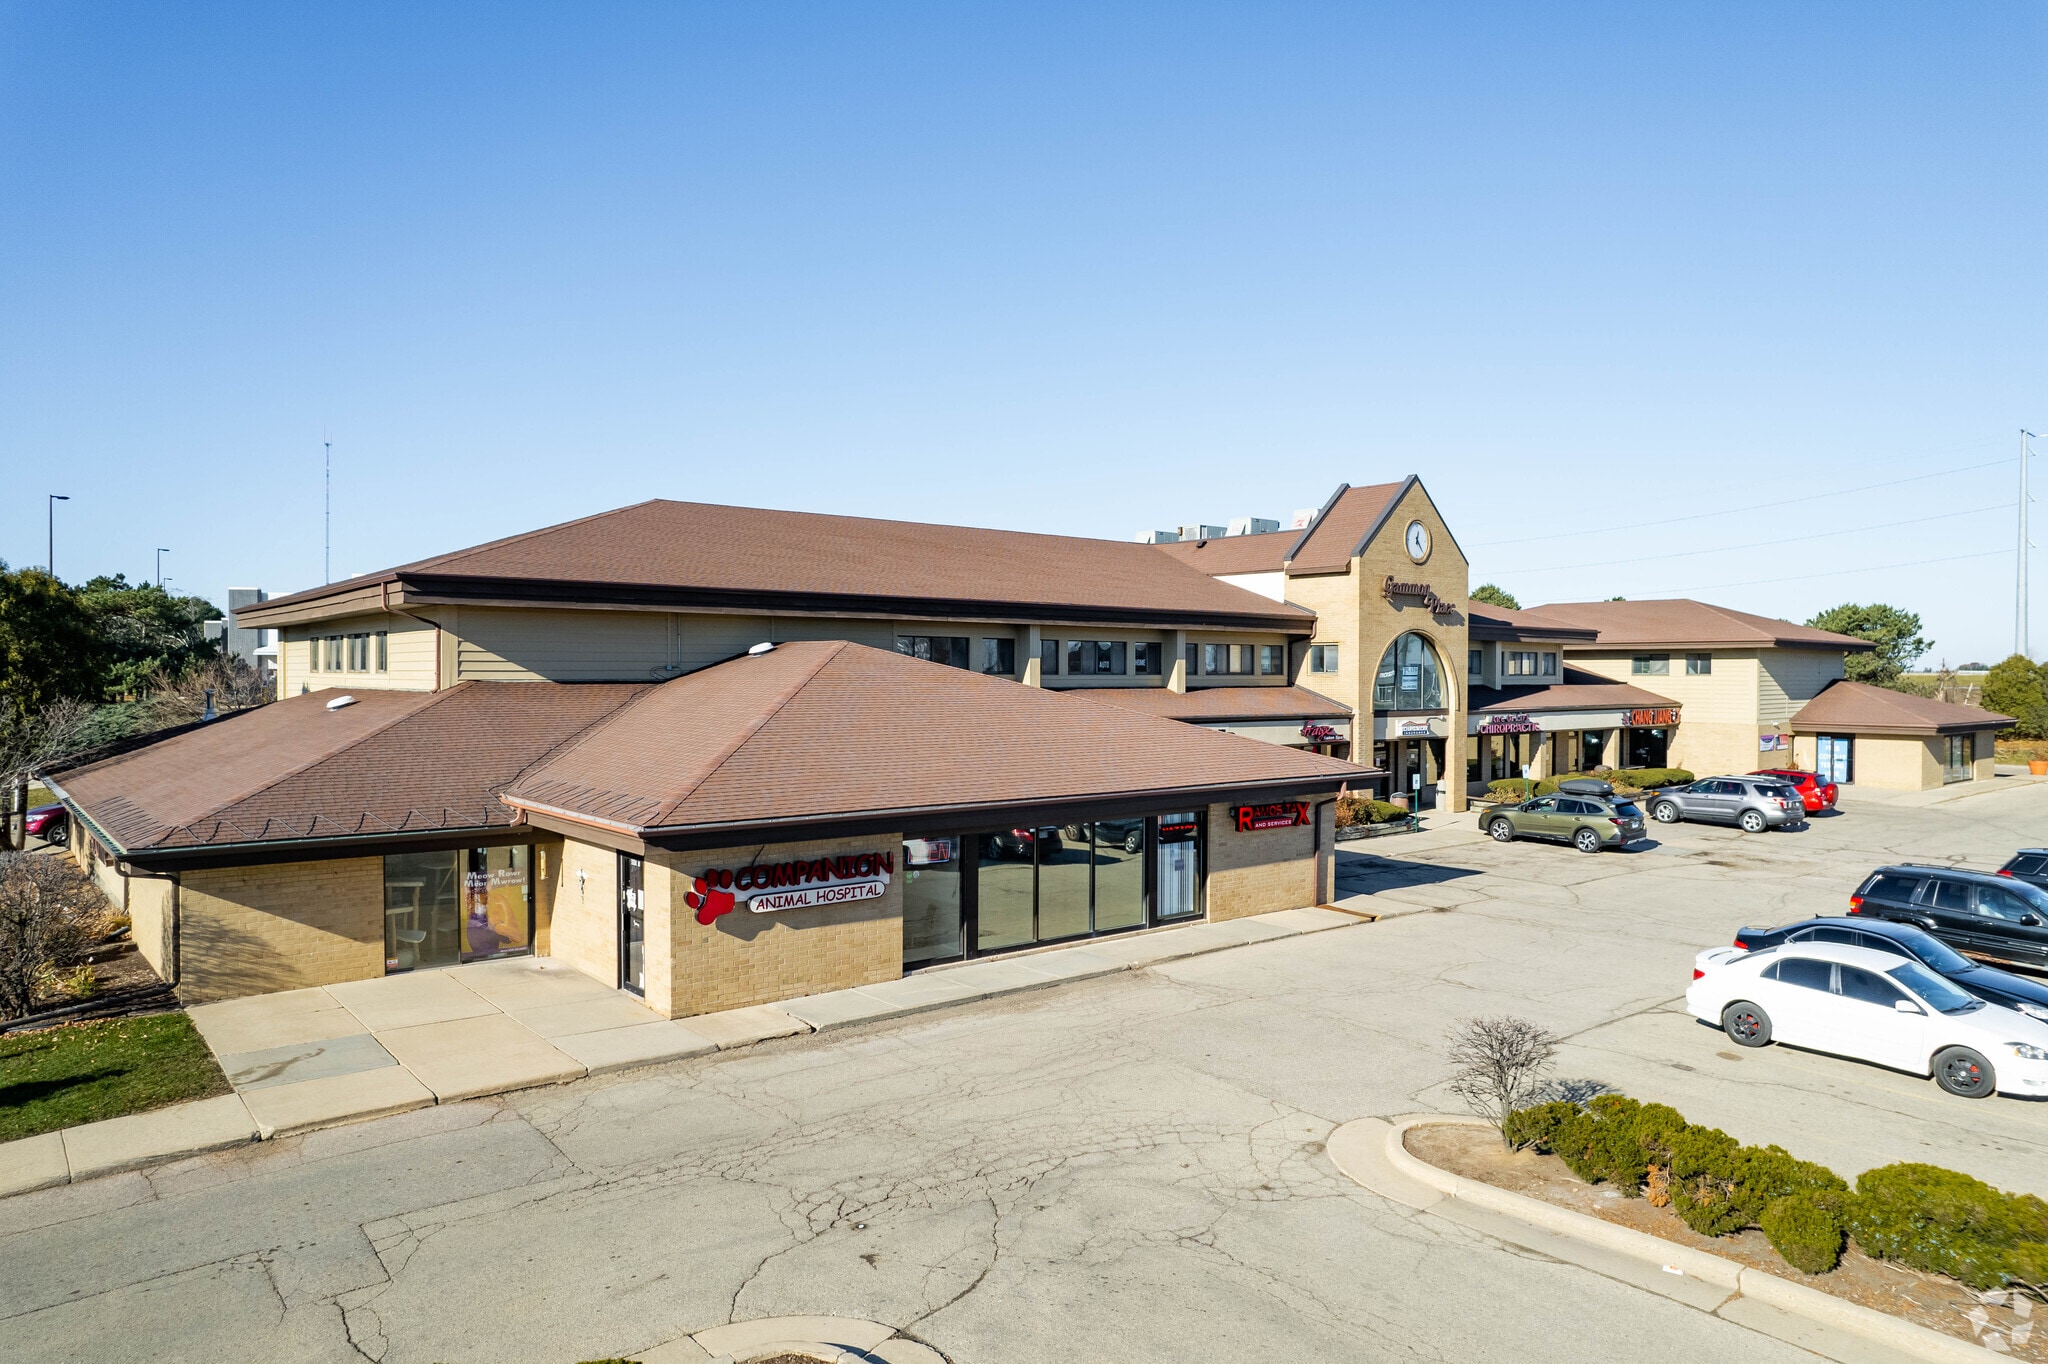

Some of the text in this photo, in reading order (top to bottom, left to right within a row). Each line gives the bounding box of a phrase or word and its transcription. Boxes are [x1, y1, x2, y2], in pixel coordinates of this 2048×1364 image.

[1480, 722, 1541, 734] CHIROPRACTIC
[1631, 709, 1653, 726] CHANG
[735, 851, 894, 892] COMPANION
[755, 885, 881, 911] ANIMAL HOSPITAL
